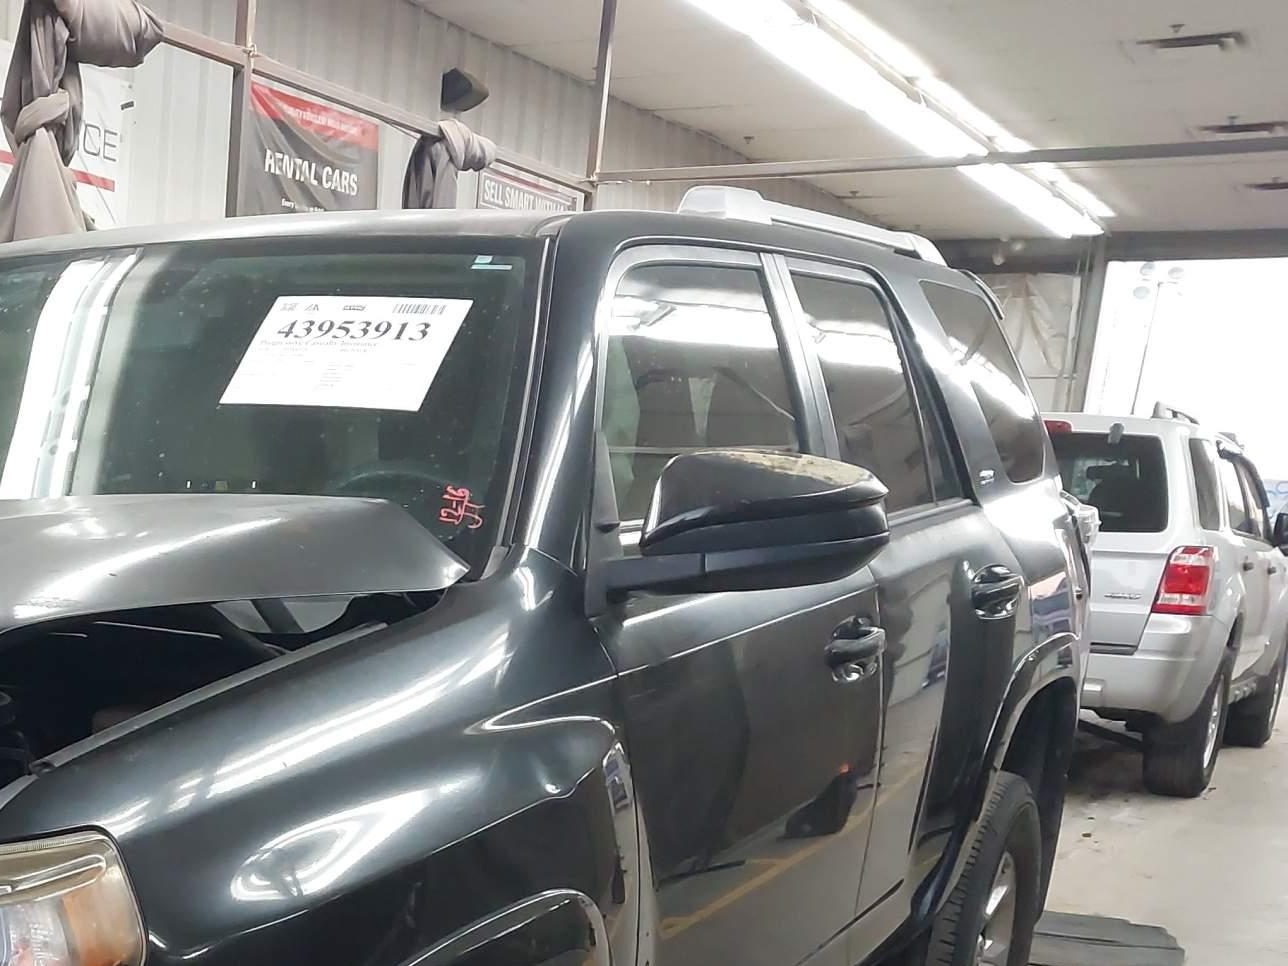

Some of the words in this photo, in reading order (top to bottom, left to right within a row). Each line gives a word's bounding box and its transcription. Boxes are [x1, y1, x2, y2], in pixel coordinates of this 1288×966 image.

[264, 148, 319, 186] RENTAL
[322, 166, 358, 196] CARS
[484, 179, 503, 205] SELL
[504, 186, 535, 211] SMART
[277, 319, 431, 341] 43953913
[439, 484, 470, 524] 12-16
